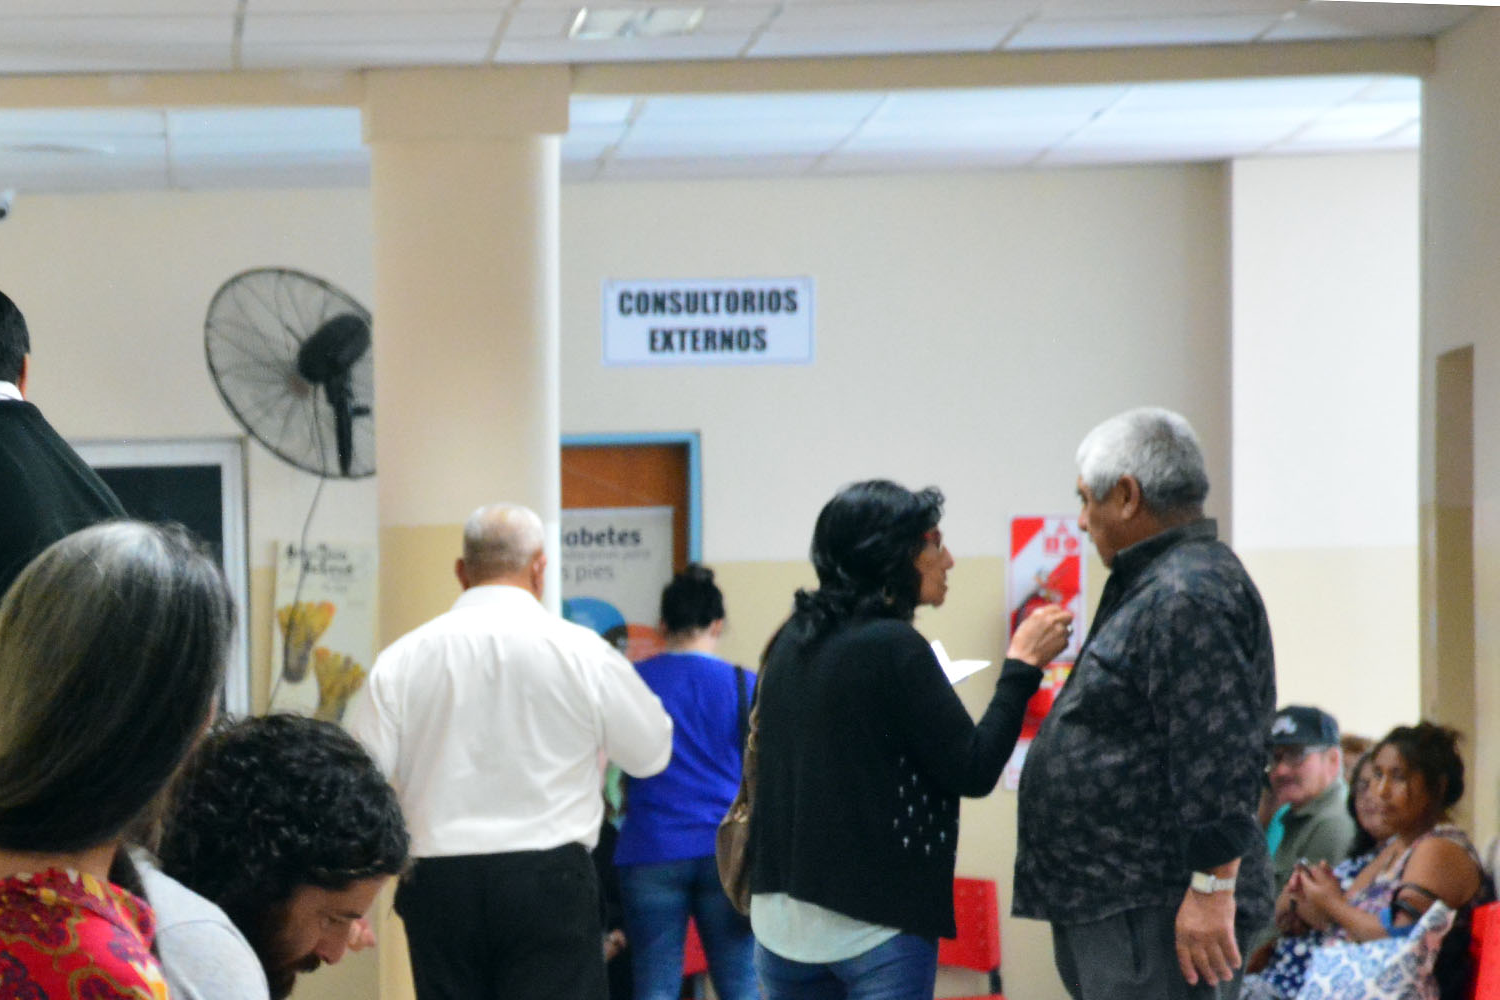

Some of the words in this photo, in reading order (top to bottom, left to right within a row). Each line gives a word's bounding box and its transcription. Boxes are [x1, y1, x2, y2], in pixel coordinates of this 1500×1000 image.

[618, 289, 799, 315] CONSULTORIOS
[649, 326, 767, 353] EXTERNOS
[562, 525, 642, 546] abetes
